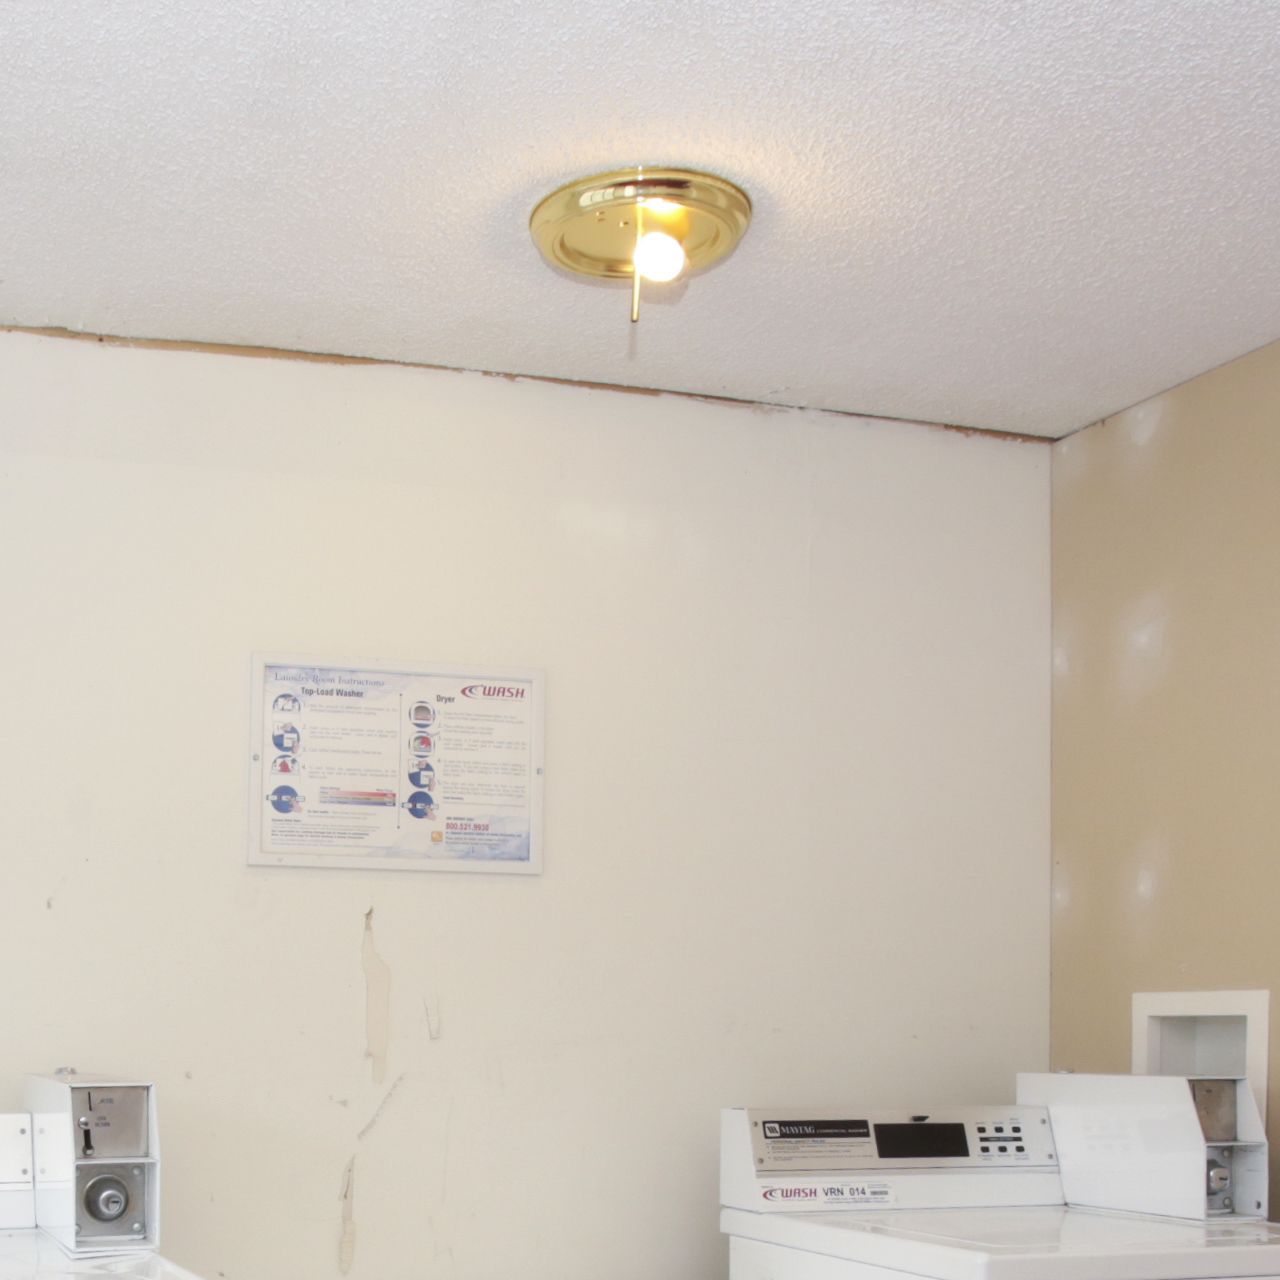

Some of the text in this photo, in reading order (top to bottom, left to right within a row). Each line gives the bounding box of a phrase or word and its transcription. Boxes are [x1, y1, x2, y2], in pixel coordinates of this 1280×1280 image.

[274, 671, 385, 687] Laundry Room Instructions
[301, 687, 364, 698] Top-Load Washer
[436, 694, 456, 704] Dryer
[780, 1124, 815, 1135] MAYTAG
[780, 1187, 817, 1198] WASH
[822, 1186, 845, 1197] VRN
[849, 1186, 867, 1197] 014
